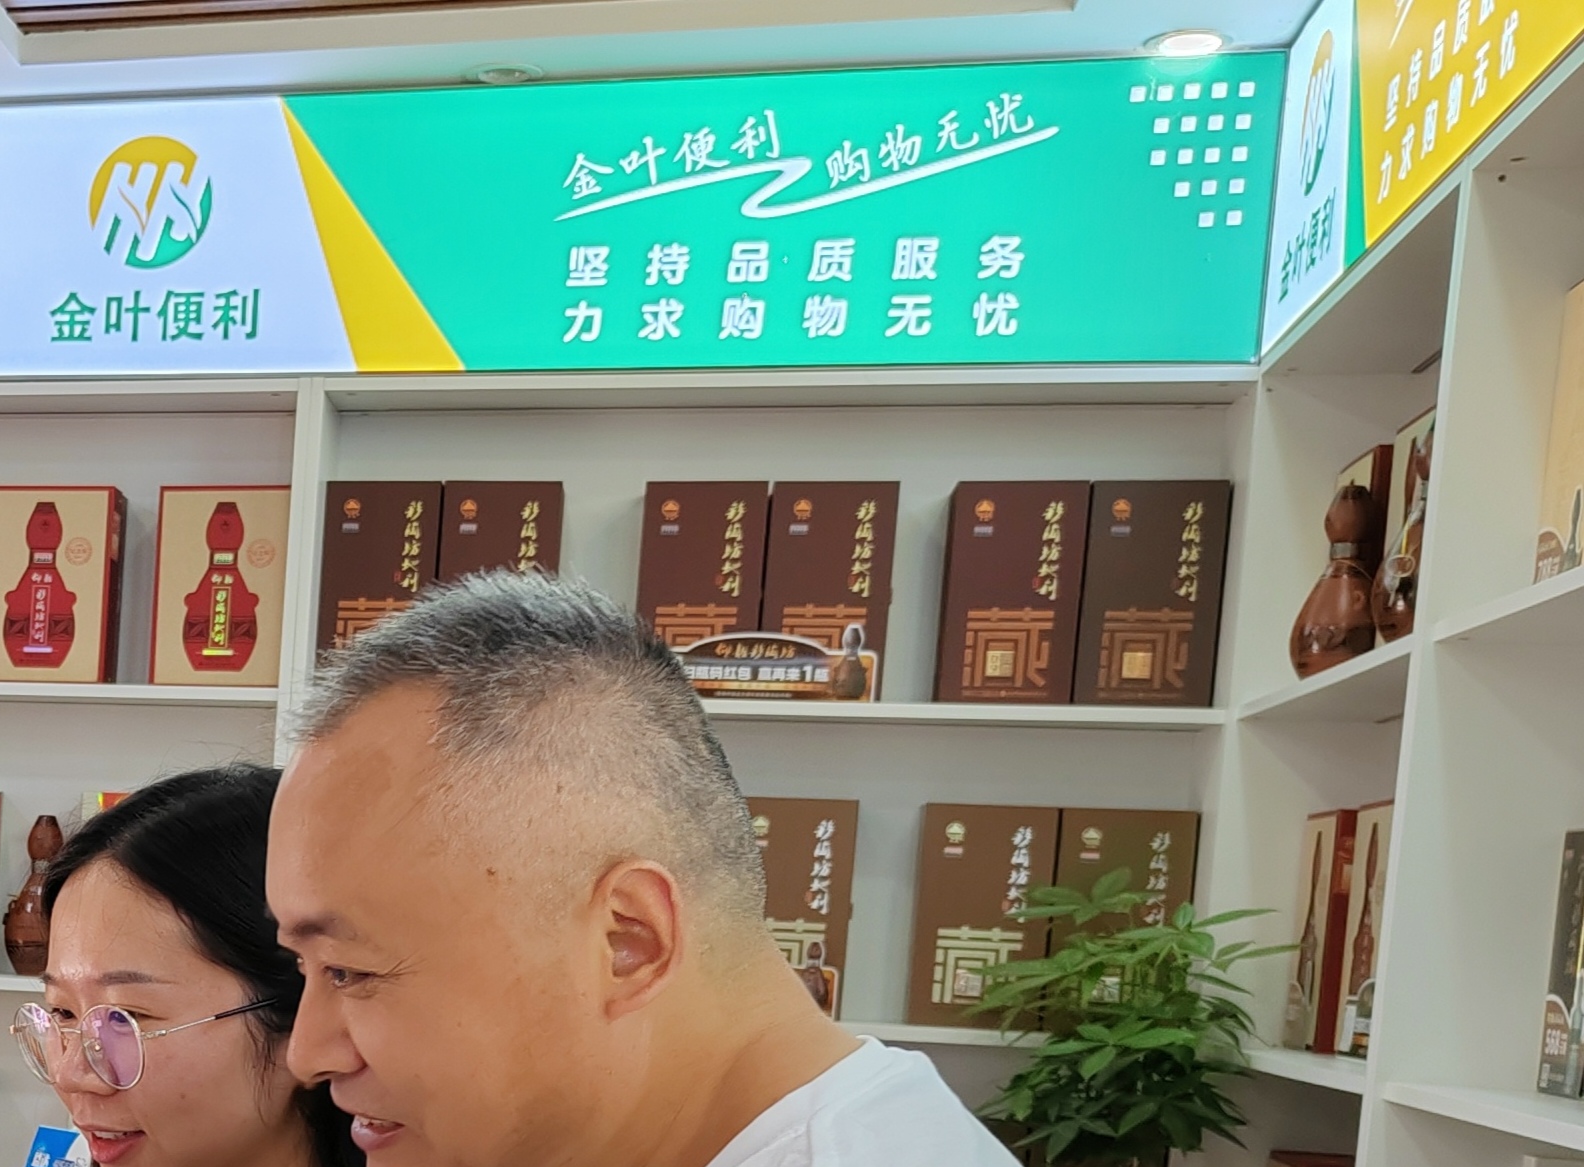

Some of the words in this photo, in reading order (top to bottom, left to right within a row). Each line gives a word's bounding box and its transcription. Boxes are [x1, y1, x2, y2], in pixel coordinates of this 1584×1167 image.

[1383, 0, 1494, 132] 坚持品质
[561, 108, 783, 201] 金叶便利
[824, 92, 1035, 189] 购物无忧
[565, 234, 1025, 288] 坚持品质服务
[49, 288, 261, 342] 金叶便利
[562, 291, 1021, 343] 力求购物无忧
